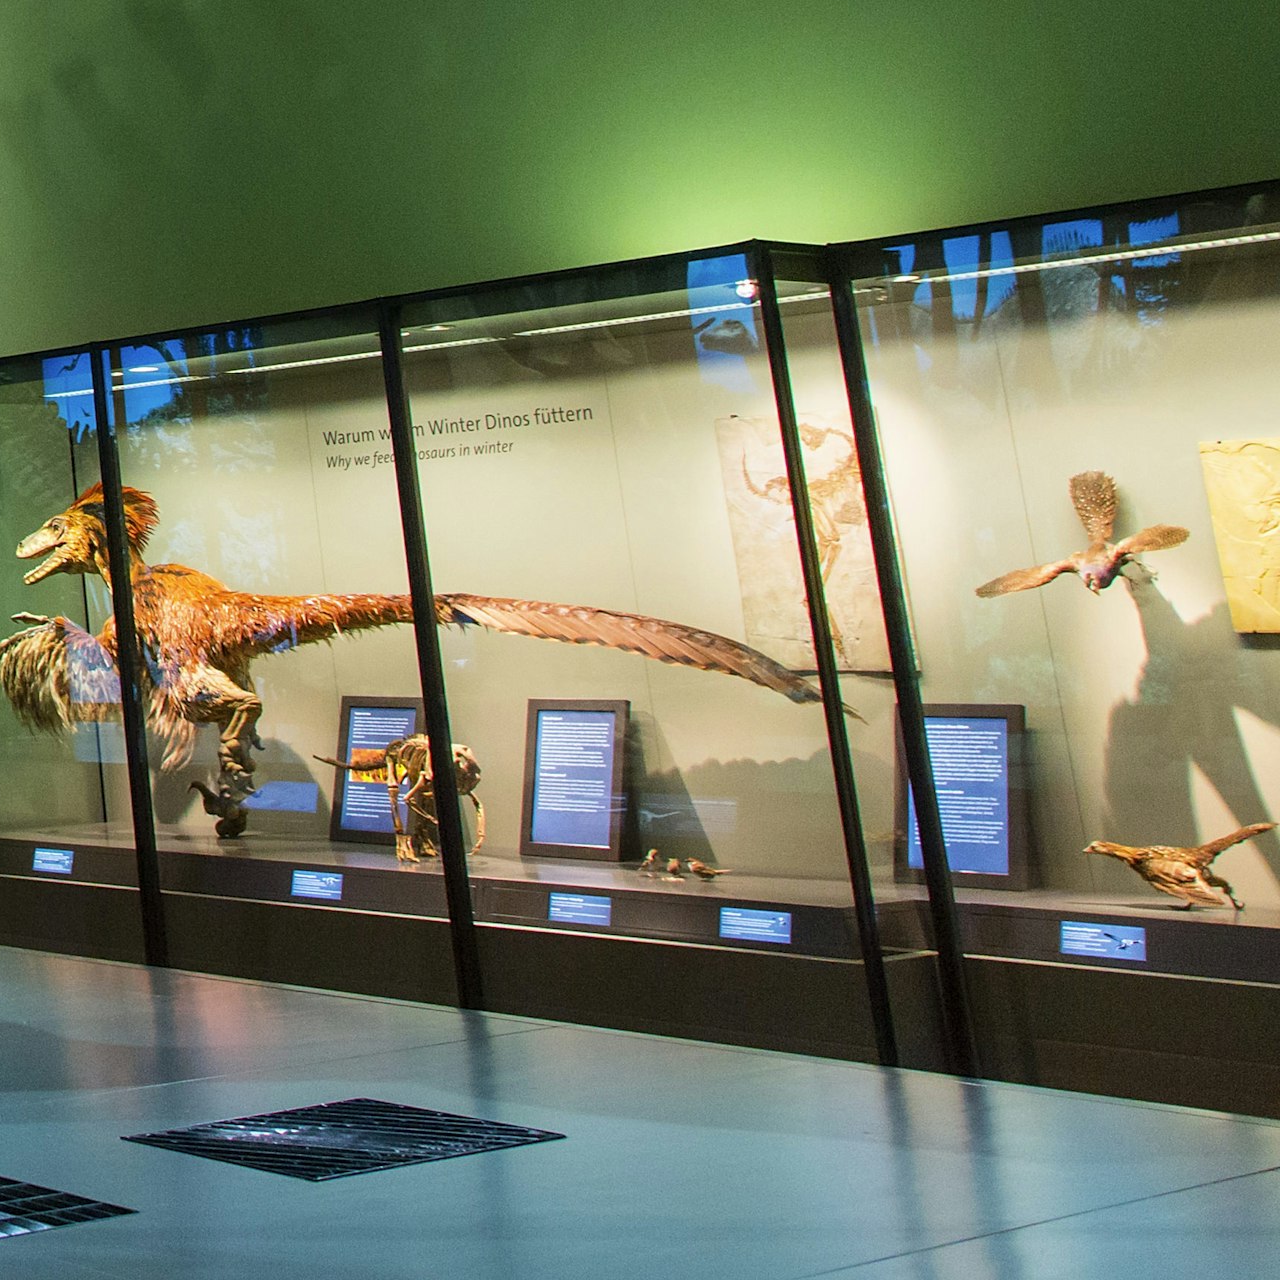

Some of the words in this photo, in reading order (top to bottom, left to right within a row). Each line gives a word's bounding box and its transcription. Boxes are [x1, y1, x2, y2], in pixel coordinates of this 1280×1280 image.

[322, 430, 375, 446] Warum
[427, 417, 481, 435] Winter
[485, 412, 530, 430] Dinos
[533, 407, 593, 425] füttern
[326, 455, 352, 471] Why
[354, 455, 370, 466] we
[418, 447, 456, 460] osaurs
[459, 443, 470, 457] in
[473, 441, 514, 455] winter
